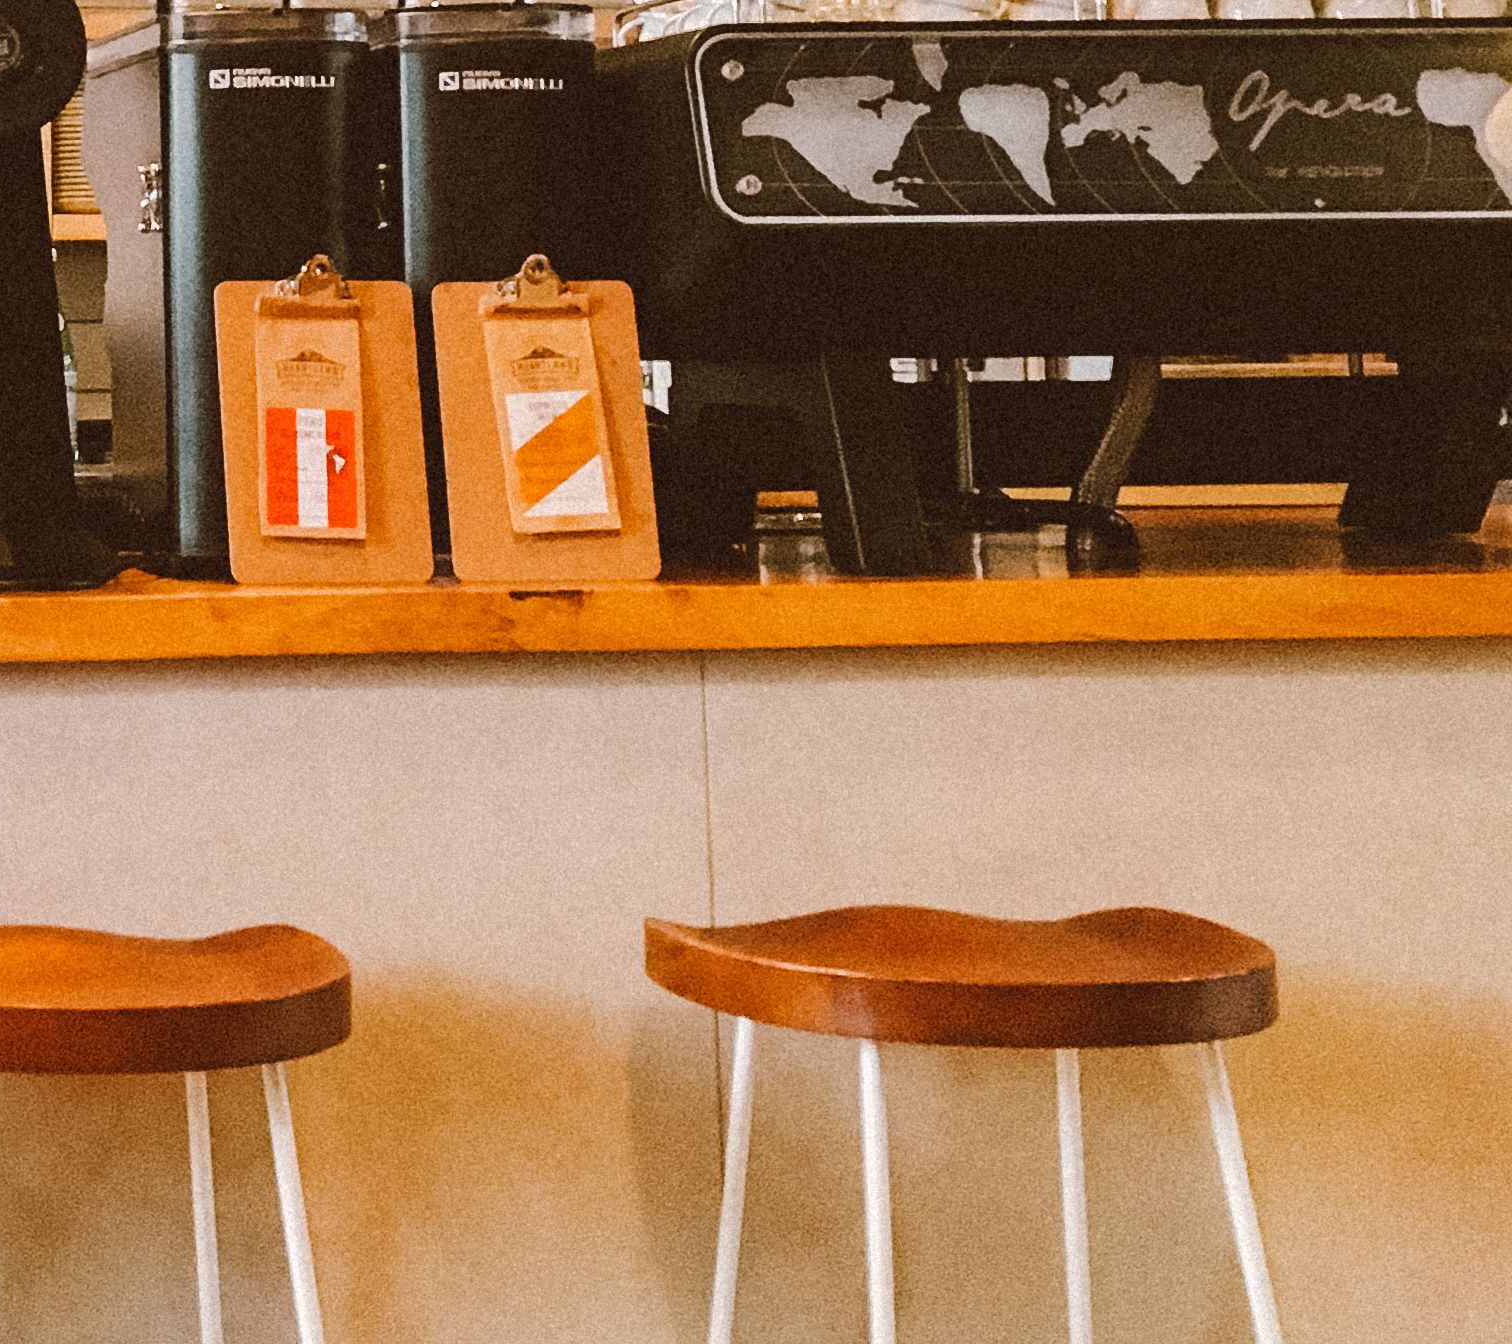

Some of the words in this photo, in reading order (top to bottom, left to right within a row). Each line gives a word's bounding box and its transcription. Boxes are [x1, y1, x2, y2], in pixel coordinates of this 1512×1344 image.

[232, 75, 336, 89] SIMONELLI
[462, 77, 564, 91] SIMONELLI
[1229, 69, 1413, 153] Opera
